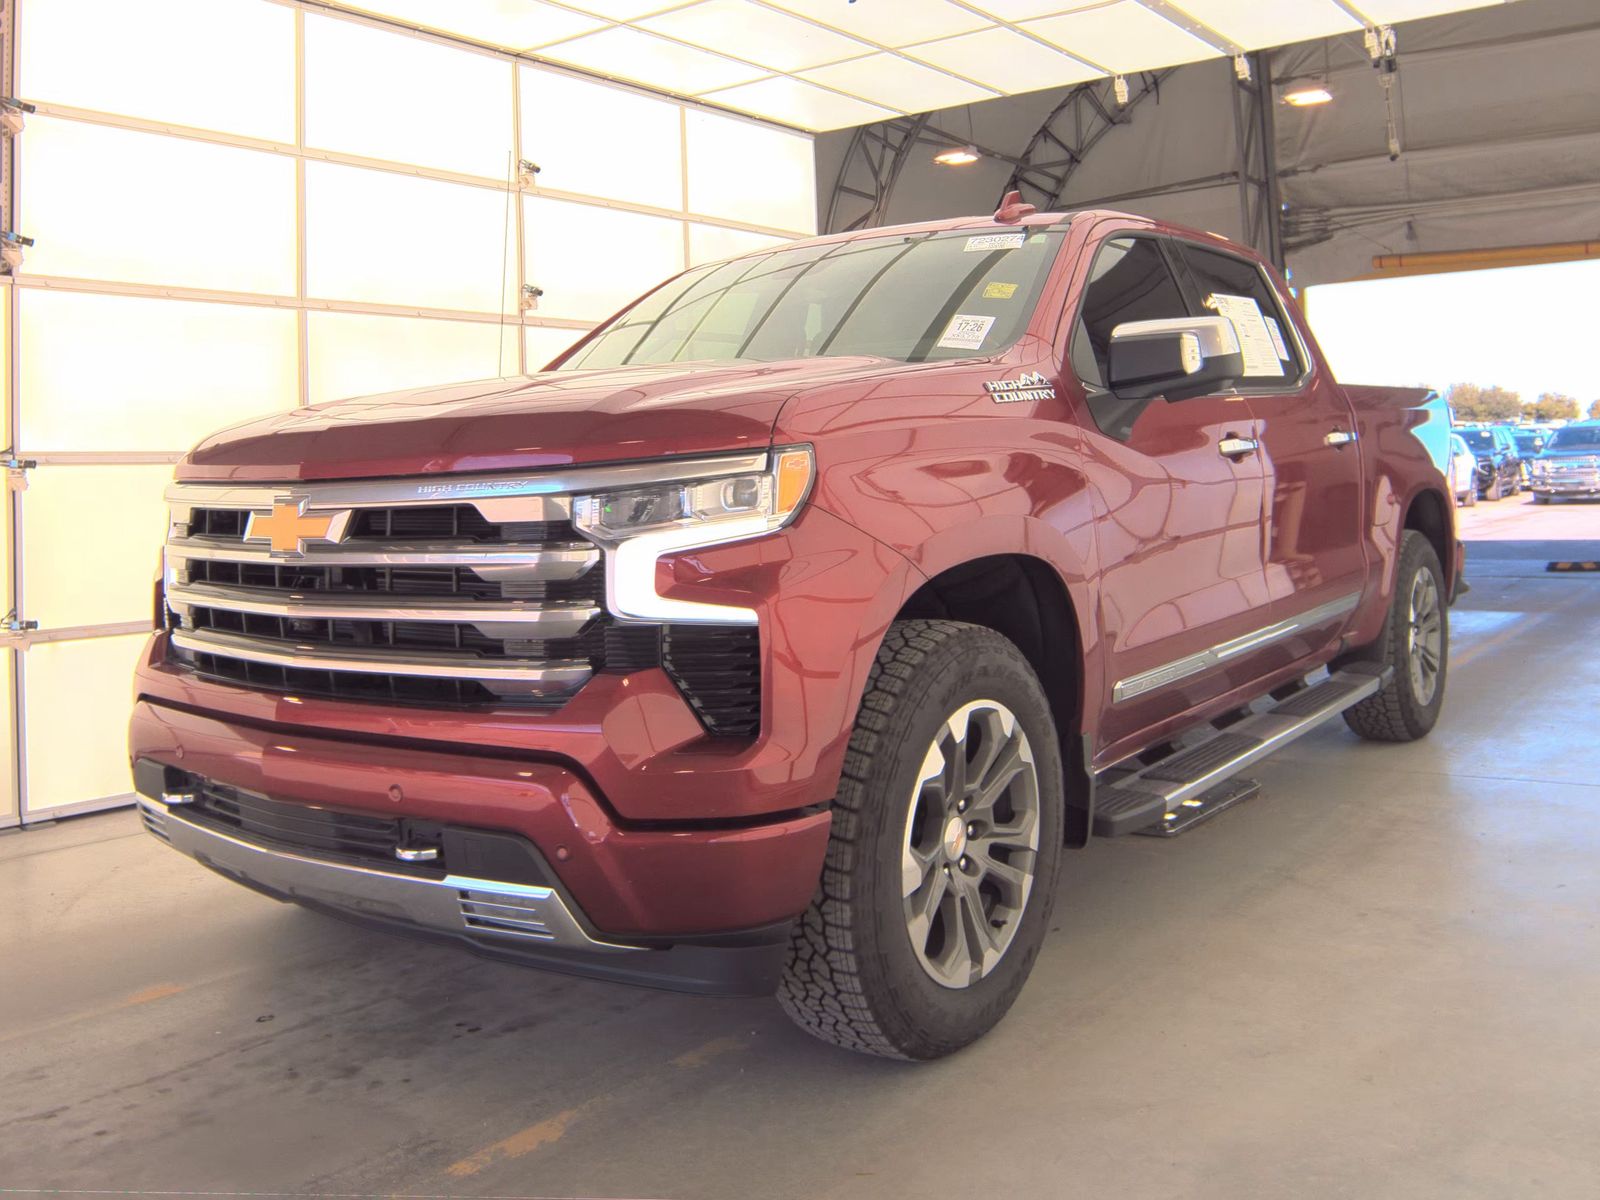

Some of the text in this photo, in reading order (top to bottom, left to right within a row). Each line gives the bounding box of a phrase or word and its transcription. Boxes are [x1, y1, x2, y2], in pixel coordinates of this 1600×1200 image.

[957, 322, 985, 332] 17:26
[984, 380, 1022, 392] HIGH
[992, 389, 1056, 403] COUNTRY
[417, 480, 528, 493] HIGH COUNTRY
